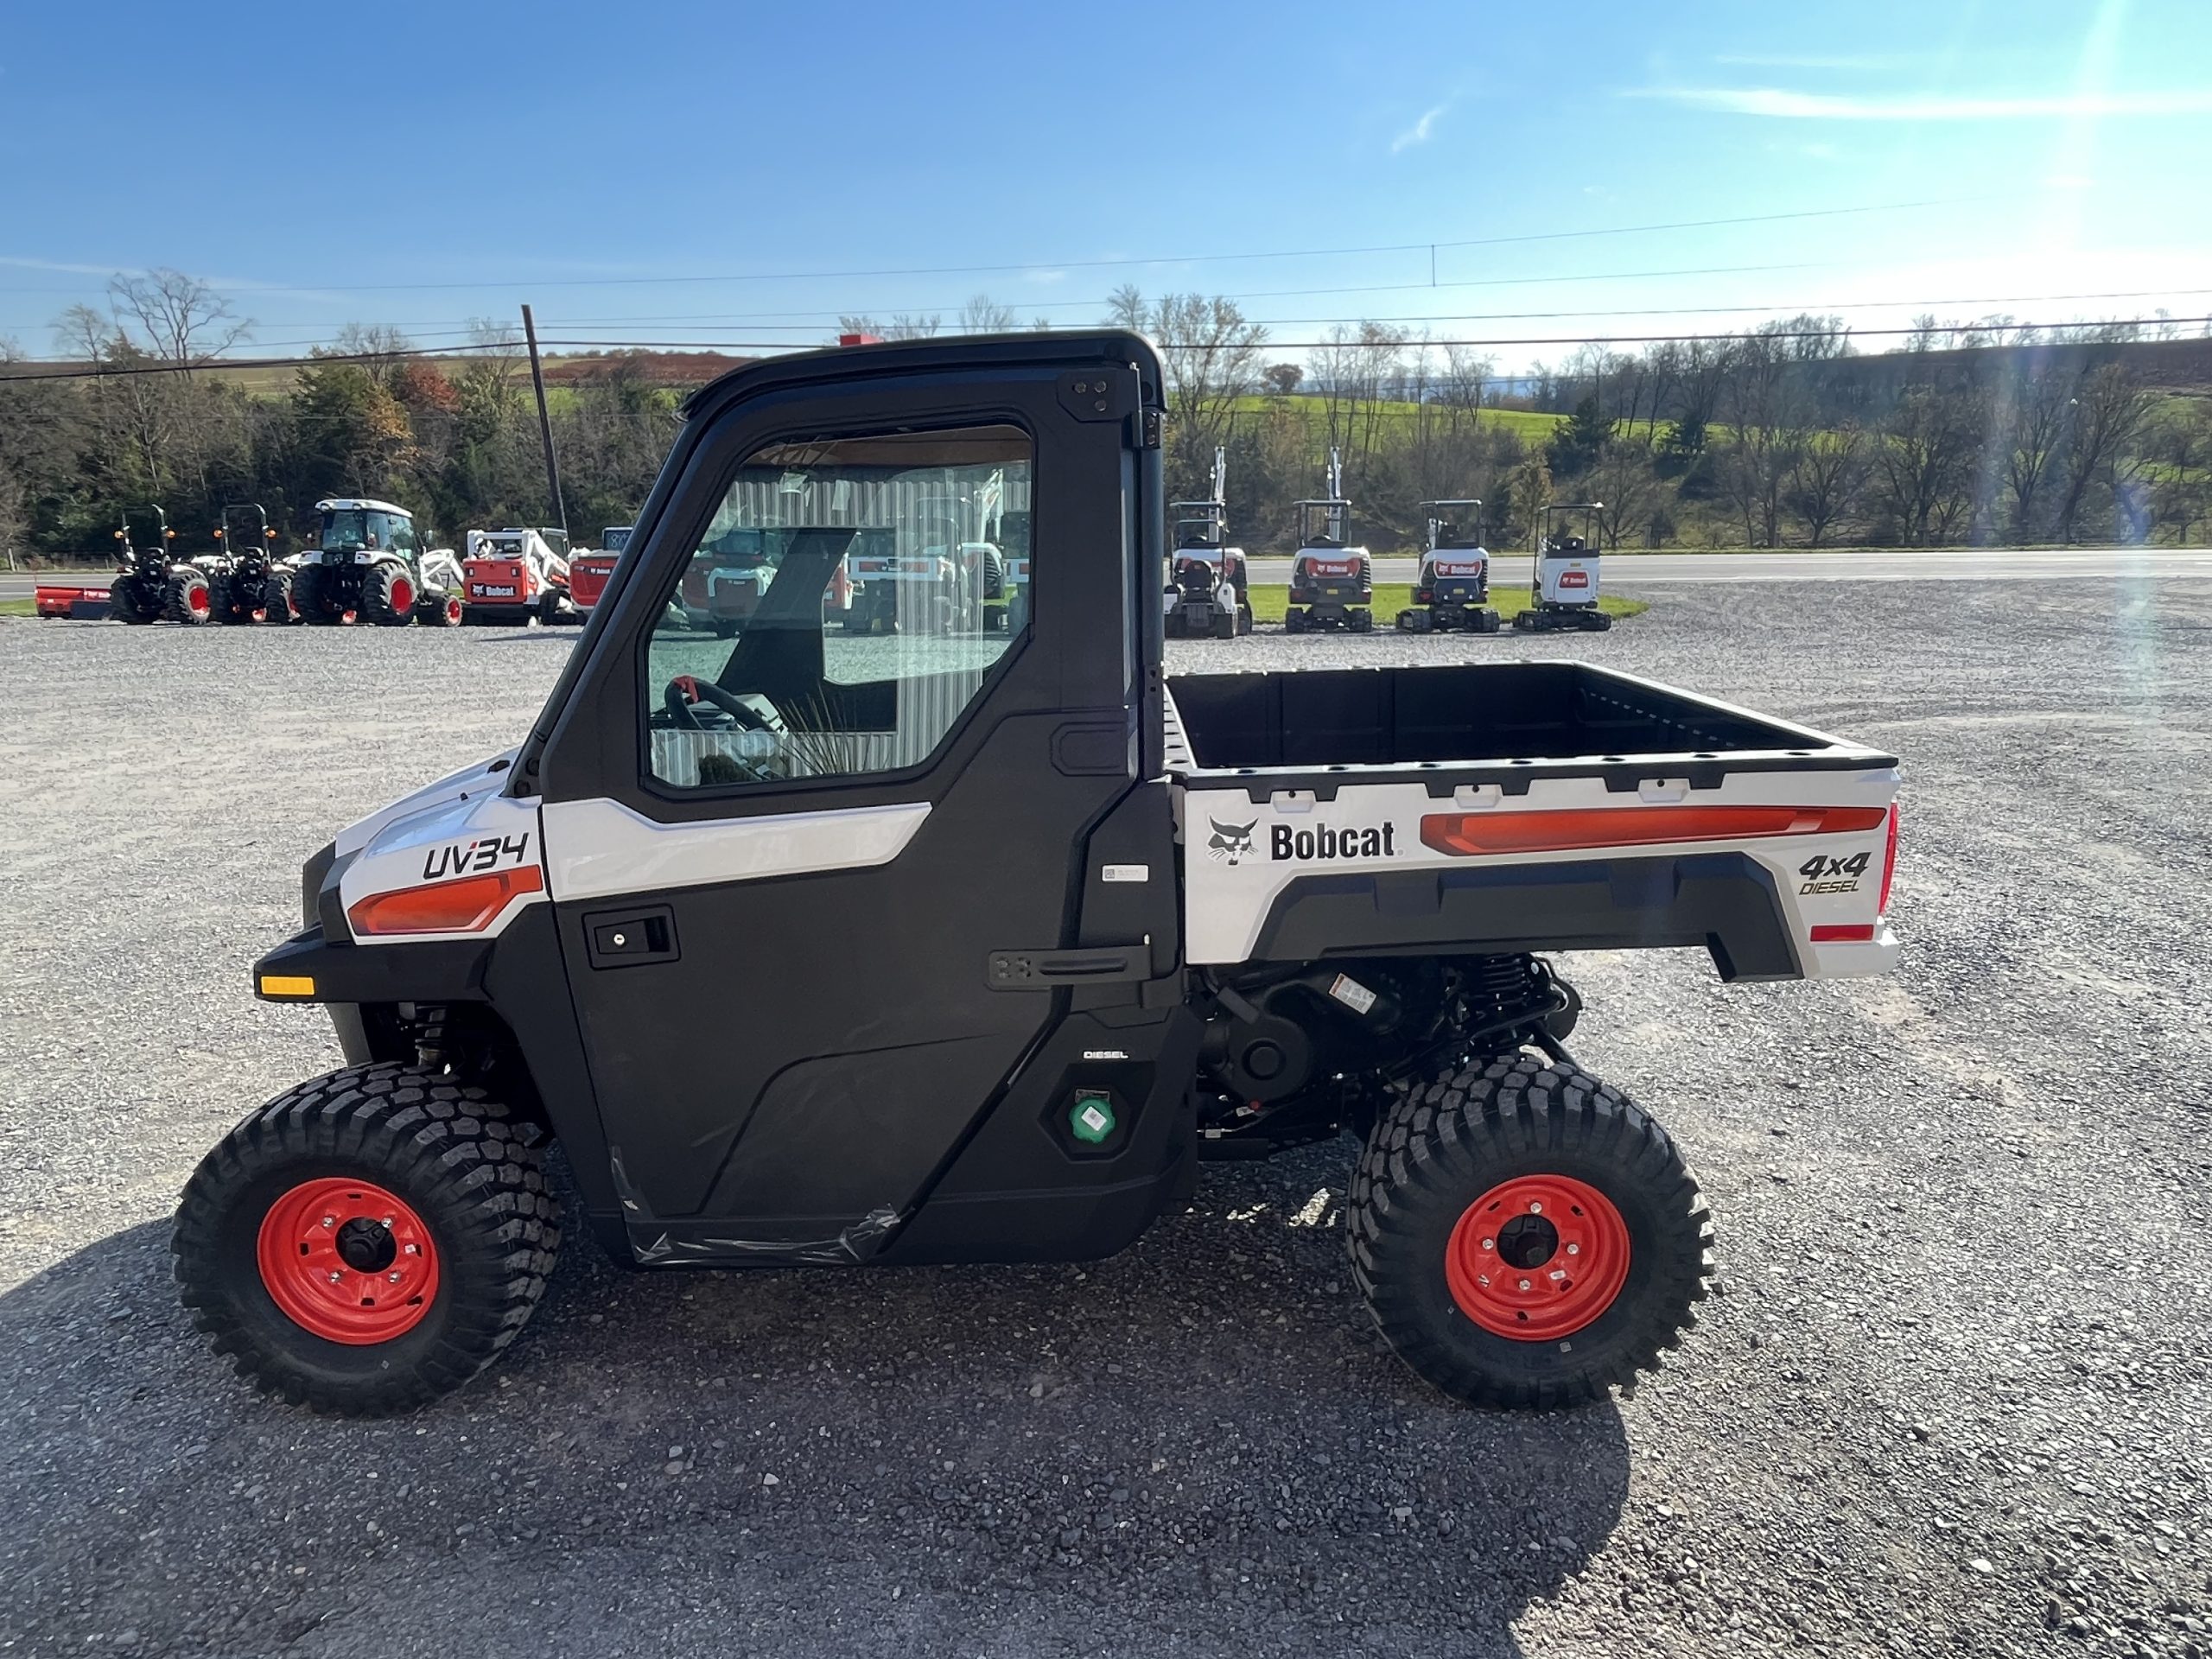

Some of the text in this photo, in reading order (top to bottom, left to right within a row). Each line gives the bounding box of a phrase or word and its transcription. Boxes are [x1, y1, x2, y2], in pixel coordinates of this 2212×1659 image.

[1451, 565, 1476, 575] Bobcat
[486, 586, 514, 596] Bobcat
[1271, 821, 1394, 861] Bobcat
[423, 832, 530, 880] UV34
[1799, 852, 1872, 880] 4x4
[1799, 880, 1859, 895] DIESEL
[1083, 1051, 1129, 1059] DIESEL
